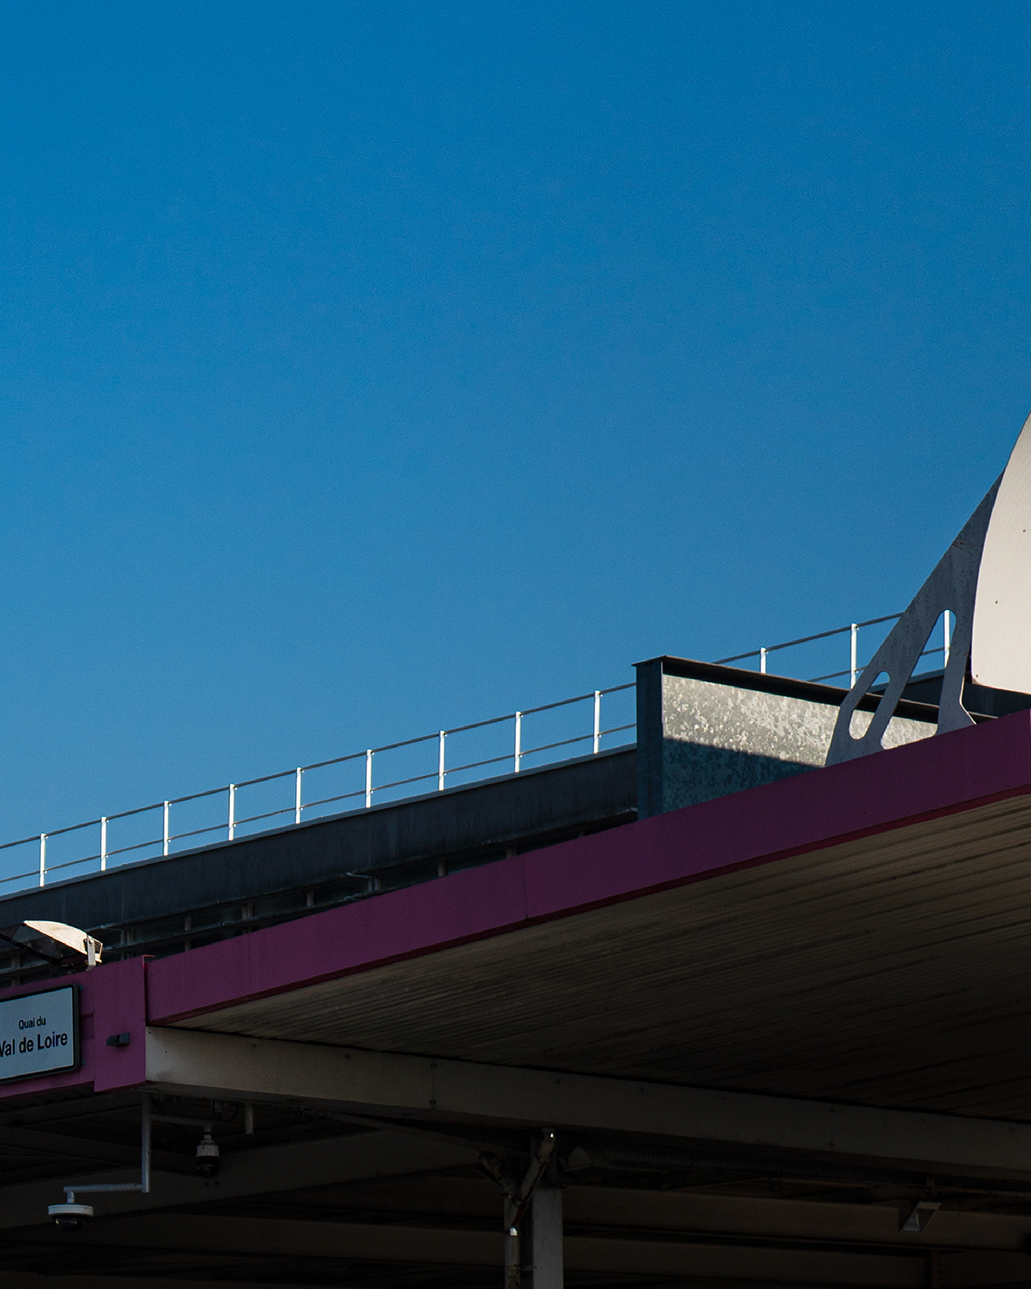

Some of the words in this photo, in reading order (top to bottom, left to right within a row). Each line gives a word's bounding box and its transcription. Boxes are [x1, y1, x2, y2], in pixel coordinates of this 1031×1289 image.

[18, 1017, 35, 1030] Quai
[36, 1016, 46, 1026] du
[19, 1037, 34, 1053] de
[37, 1031, 68, 1050] Loire
